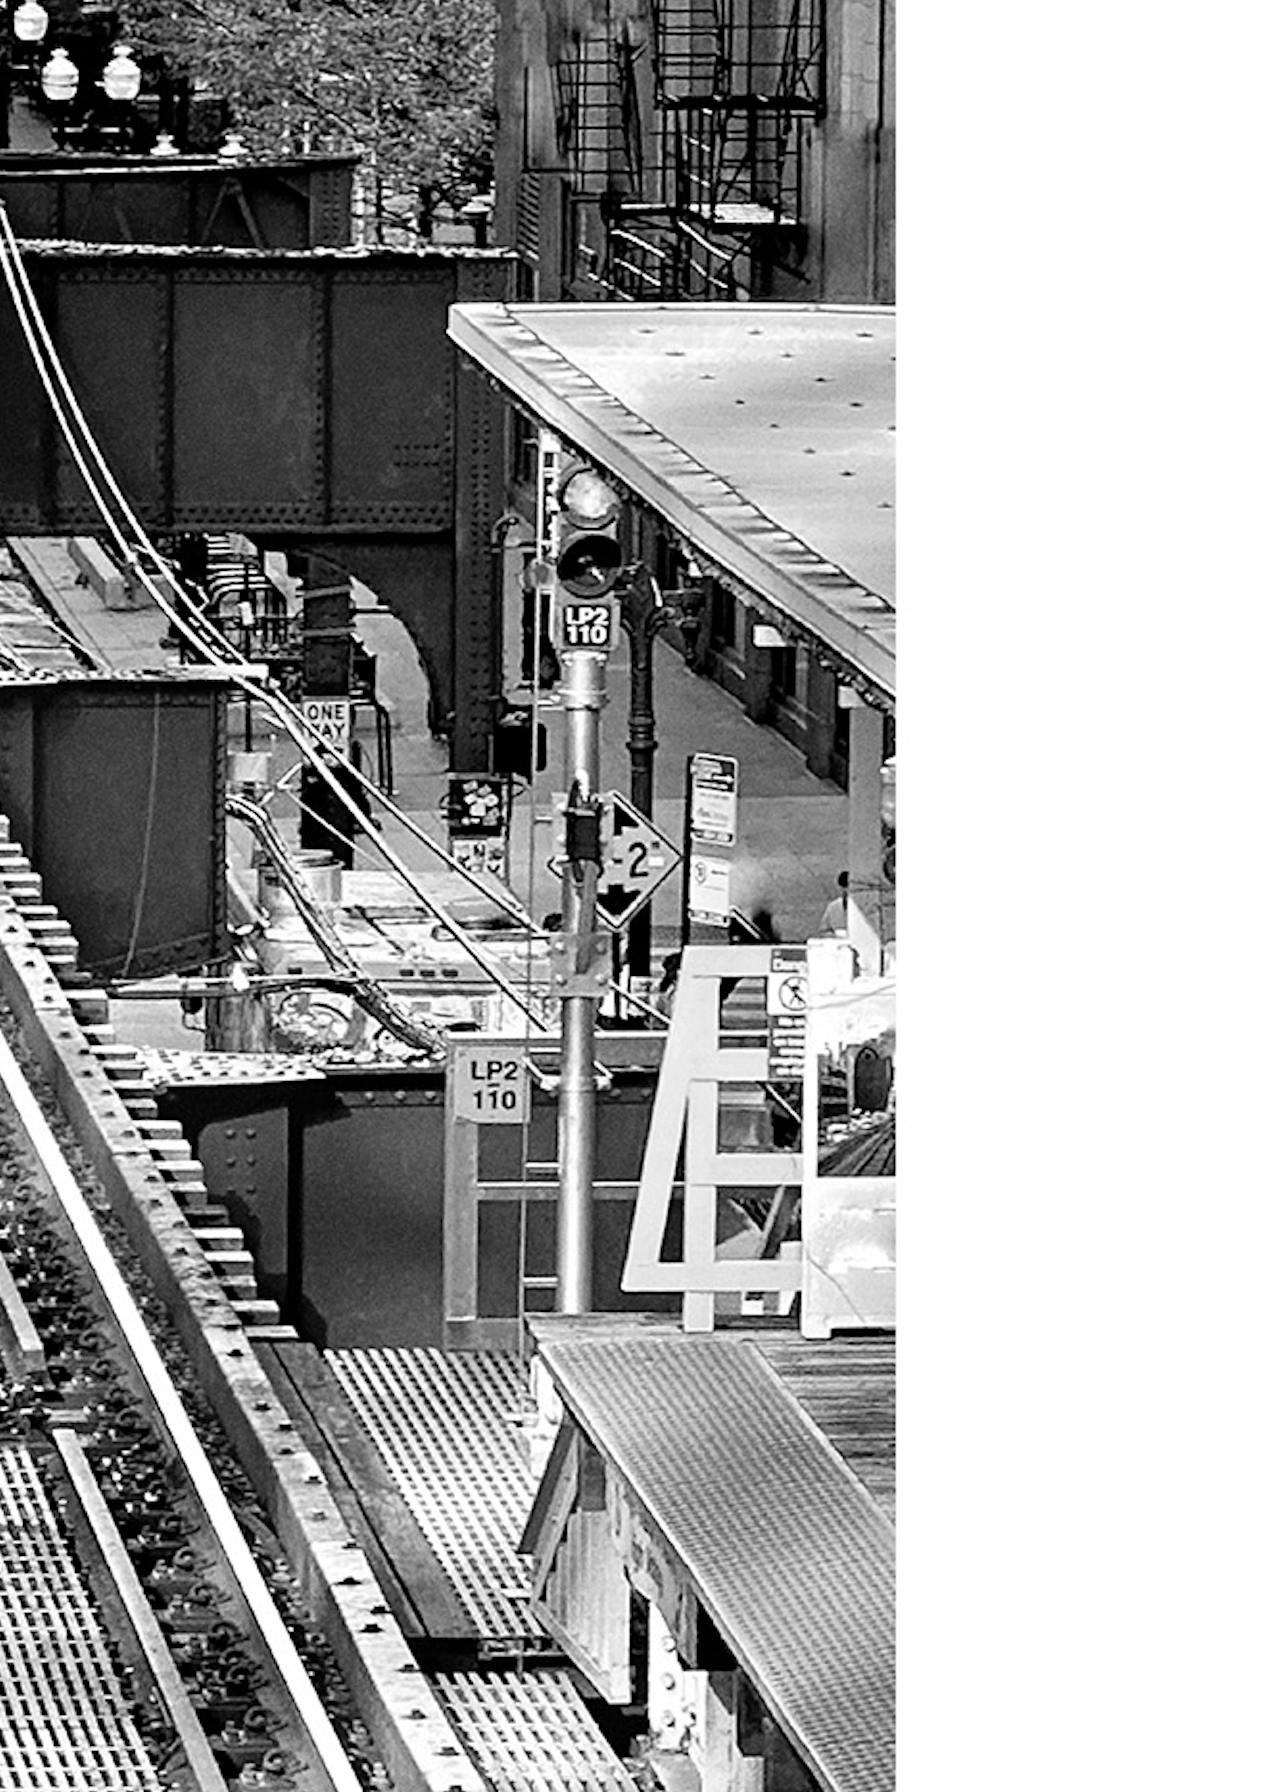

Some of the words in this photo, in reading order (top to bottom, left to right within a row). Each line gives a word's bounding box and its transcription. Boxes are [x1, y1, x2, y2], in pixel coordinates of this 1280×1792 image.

[565, 607, 610, 625] LP2
[567, 625, 608, 644] 110
[308, 704, 345, 720] ONE
[471, 1060, 518, 1080] LP2
[473, 1090, 516, 1110] 110
